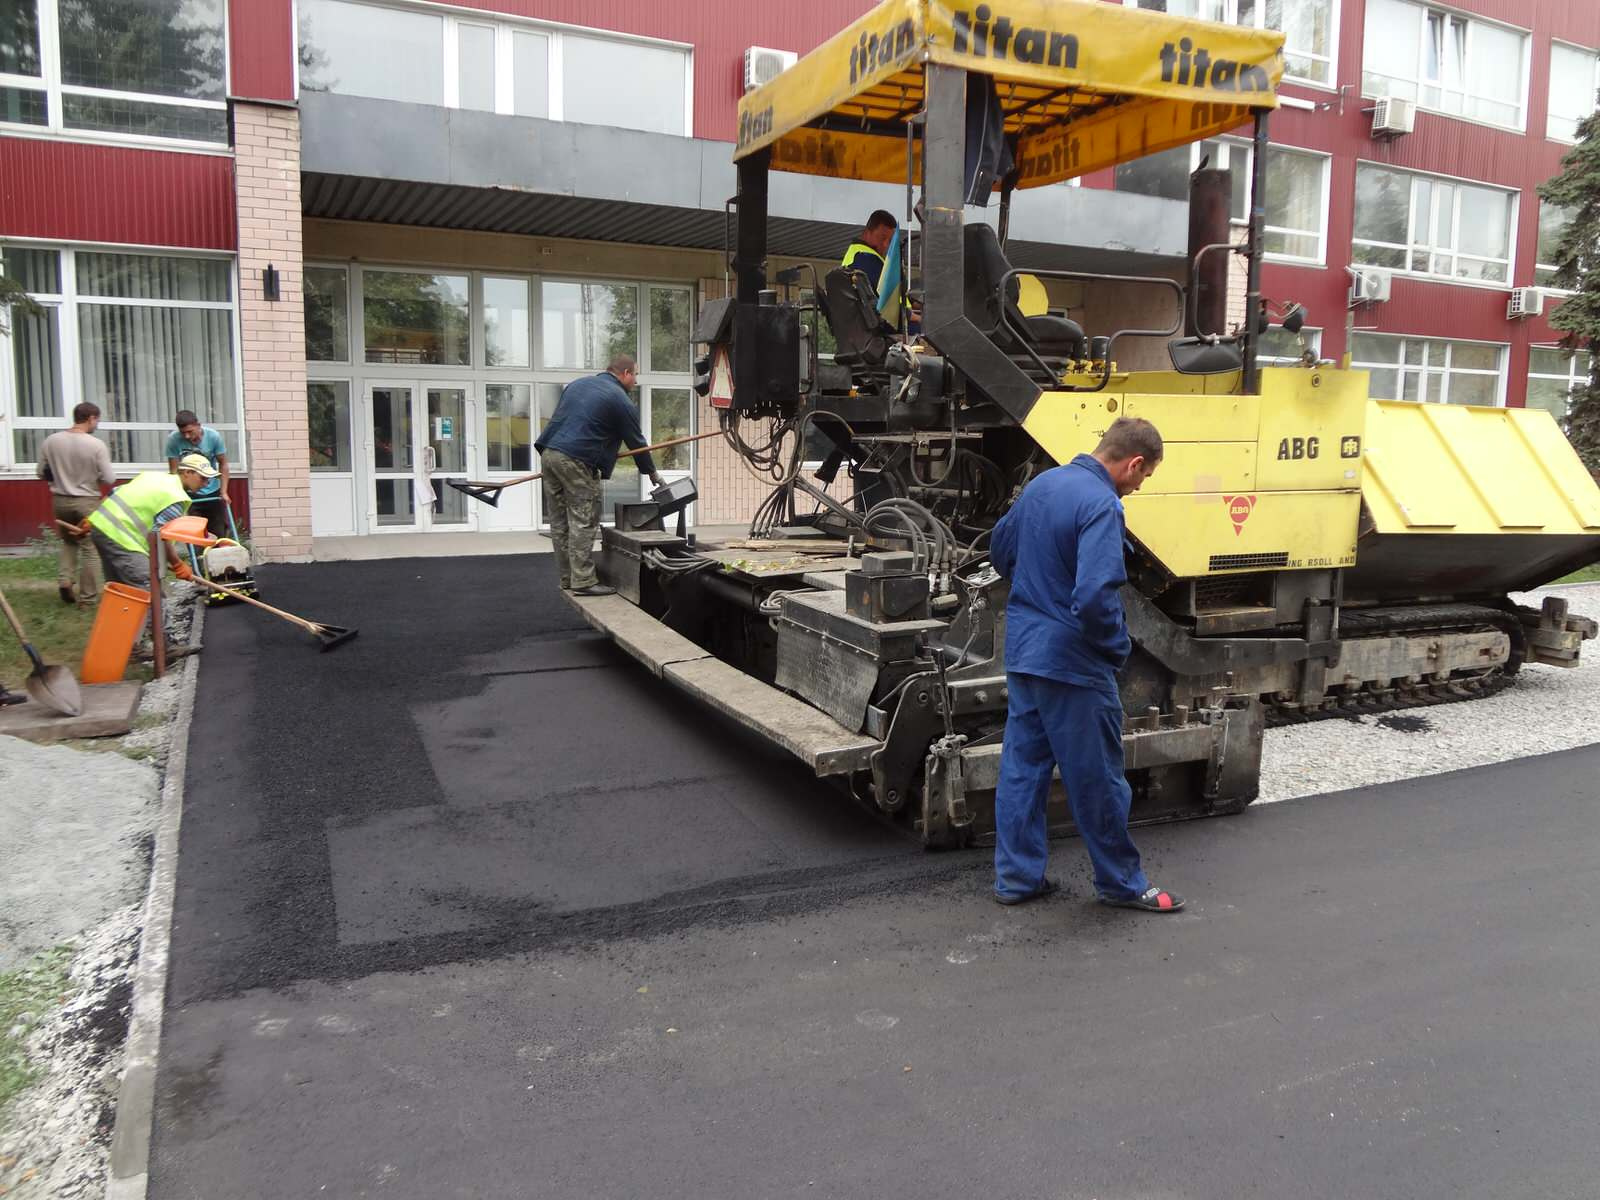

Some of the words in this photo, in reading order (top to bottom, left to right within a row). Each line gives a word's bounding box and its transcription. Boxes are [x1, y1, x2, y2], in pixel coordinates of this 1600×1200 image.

[850, 18, 915, 85] titan
[953, 4, 1079, 69] titan
[1160, 37, 1269, 92] titan
[736, 104, 773, 151] itan
[1277, 436, 1320, 460] ABG
